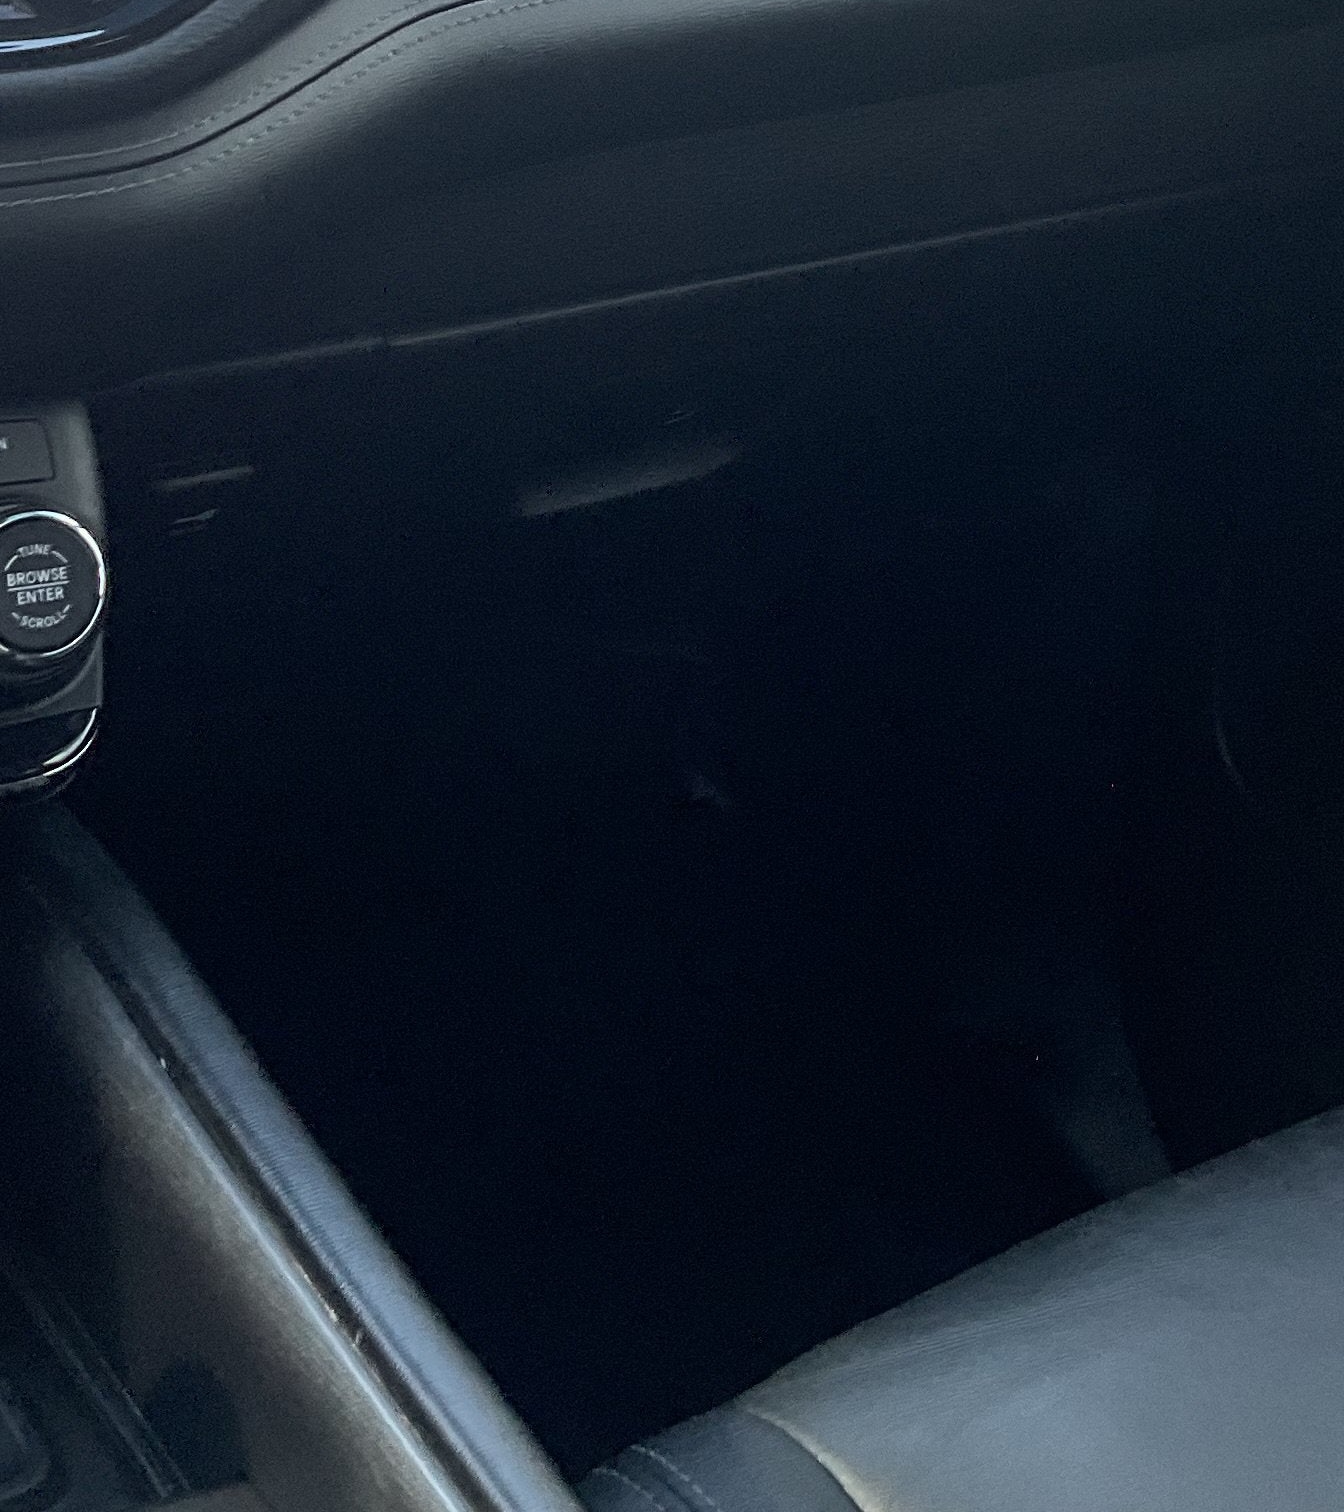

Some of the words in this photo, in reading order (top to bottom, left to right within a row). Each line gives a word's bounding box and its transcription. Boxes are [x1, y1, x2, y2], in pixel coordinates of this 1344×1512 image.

[17, 543, 53, 558] TUNE
[6, 565, 69, 587] BROWSE
[16, 586, 65, 606] ENTER
[19, 610, 67, 629] SCROLL
